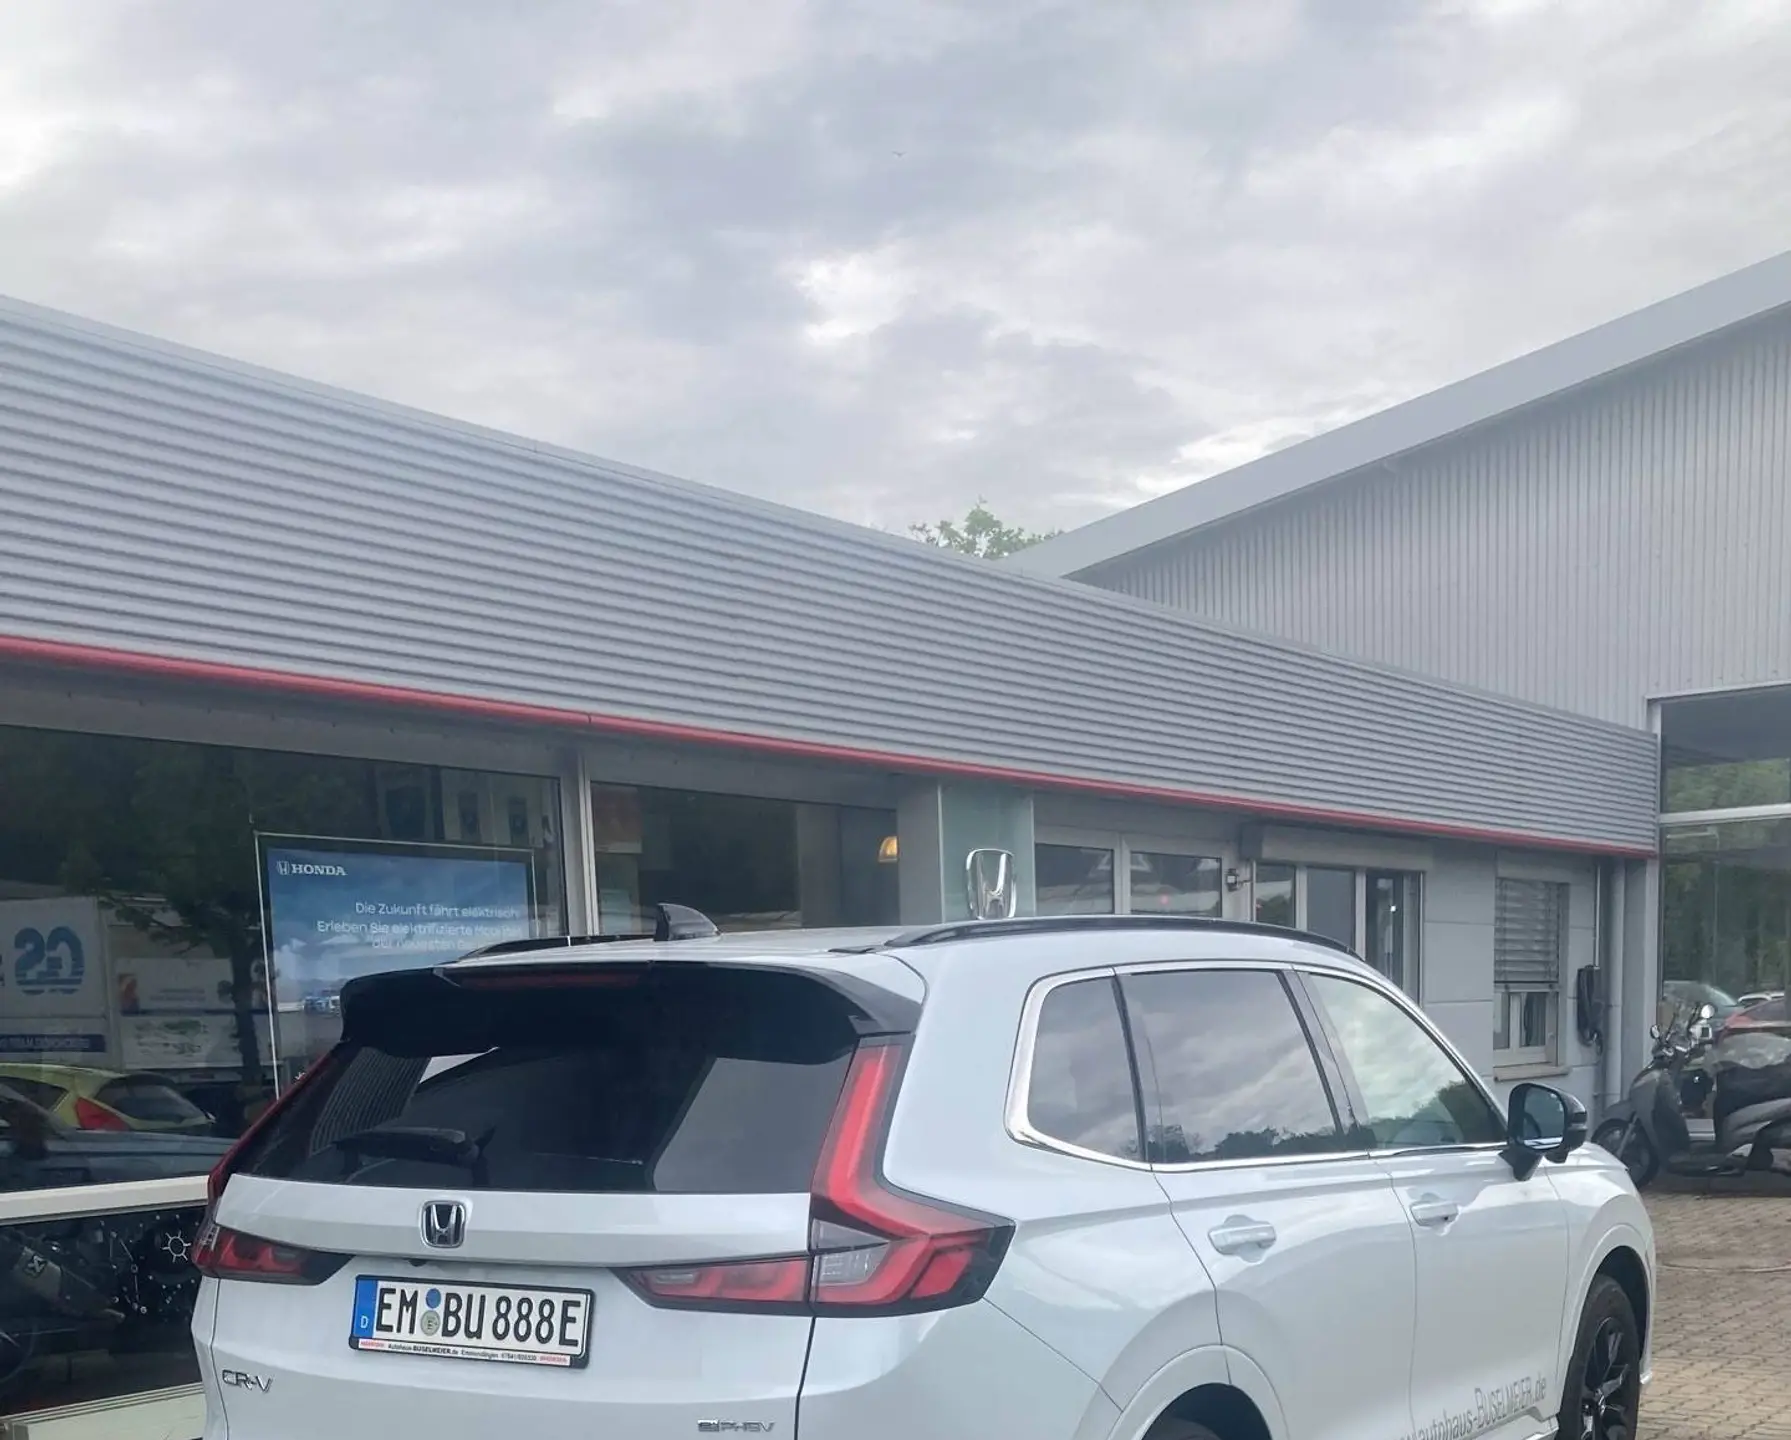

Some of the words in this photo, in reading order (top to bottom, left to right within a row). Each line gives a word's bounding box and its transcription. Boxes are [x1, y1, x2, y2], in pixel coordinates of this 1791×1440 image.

[292, 863, 347, 876] HONDA
[355, 902, 376, 915] Die
[378, 902, 426, 918] Zukunft
[428, 904, 459, 919] fährt
[316, 920, 367, 934] Erleben
[360, 1315, 370, 1329] D
[375, 1288, 419, 1335] EM
[441, 1292, 487, 1340] BU
[492, 1296, 582, 1347] 888E
[222, 1369, 273, 1393] CR-V
